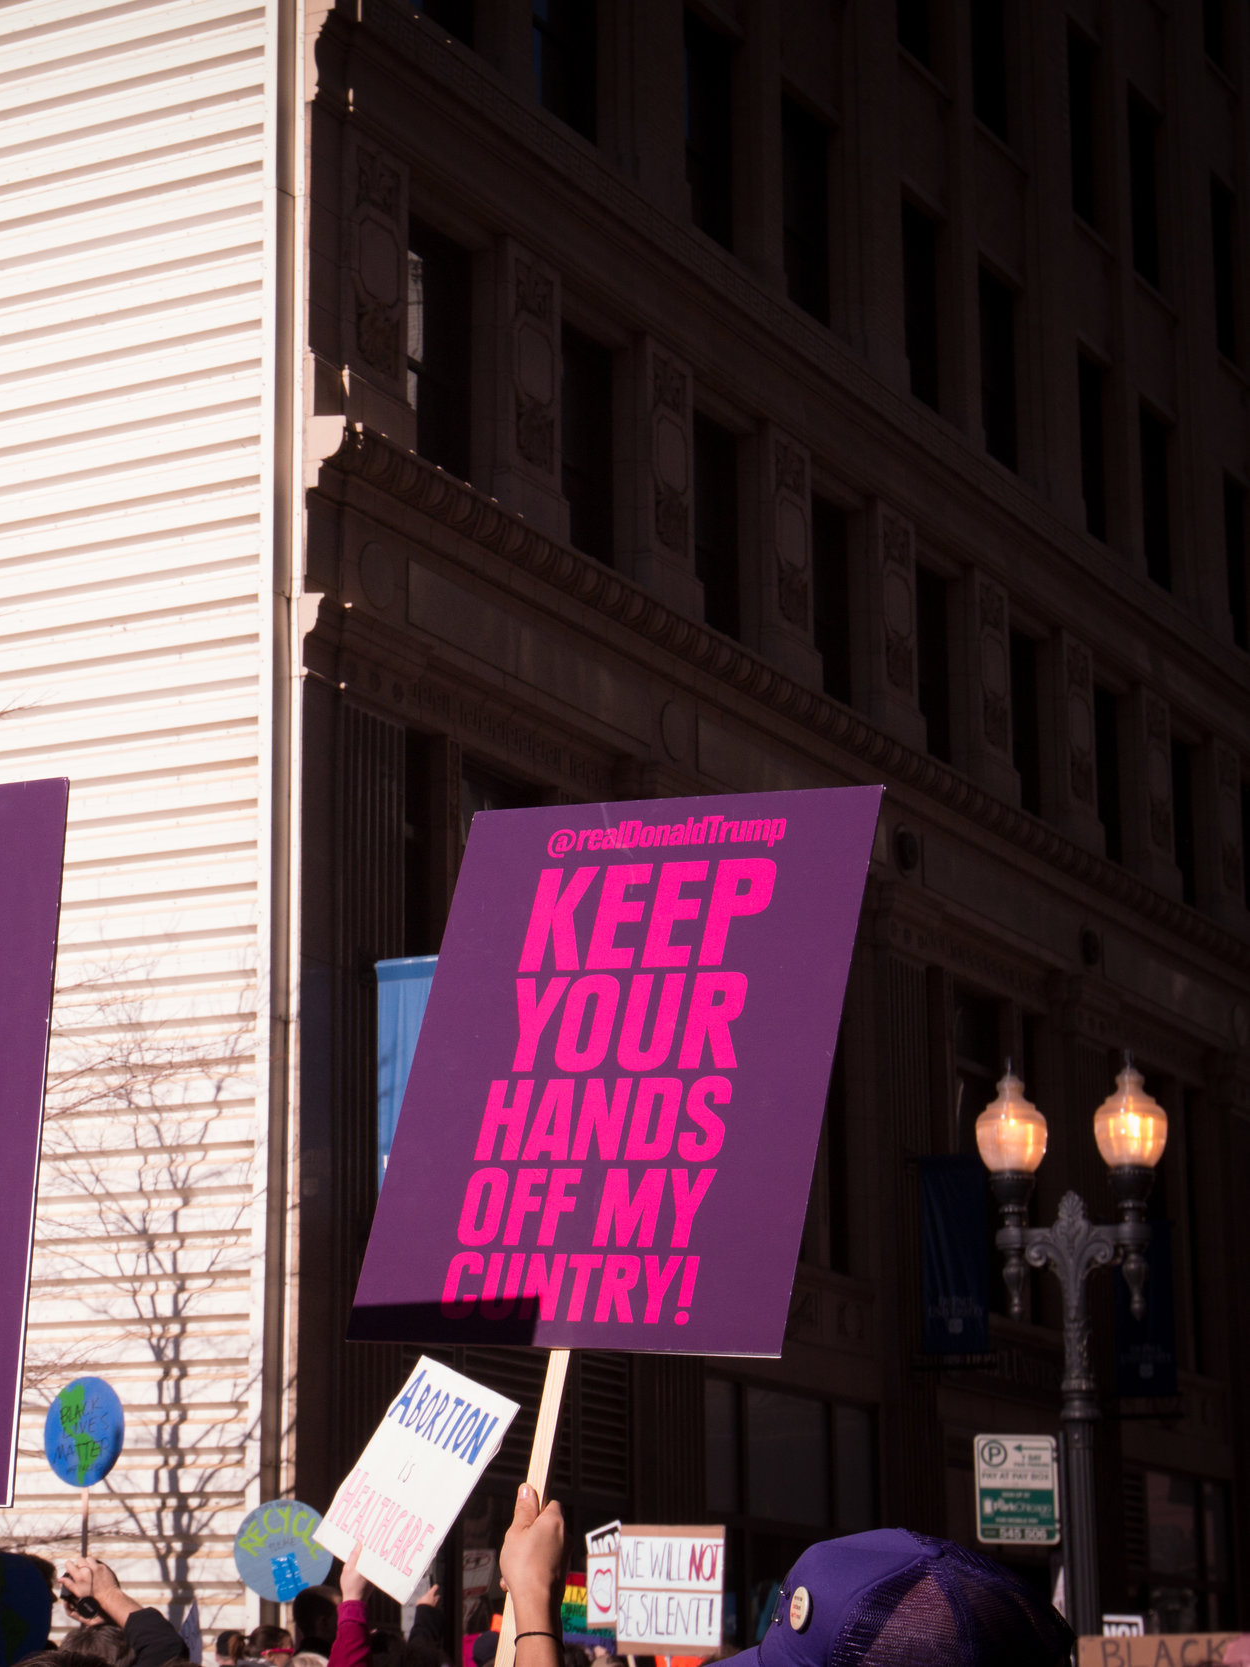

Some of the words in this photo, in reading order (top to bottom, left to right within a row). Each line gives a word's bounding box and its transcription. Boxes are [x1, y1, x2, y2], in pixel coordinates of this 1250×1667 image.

[547, 815, 788, 858] @realDonaldTrump
[518, 858, 777, 972] KEEP
[512, 972, 748, 1072] YOUR
[474, 1076, 732, 1162] HANDS
[457, 1167, 582, 1246] OFF
[592, 1168, 717, 1248] MY
[440, 1251, 701, 1326] CUNTRY!
[388, 1370, 499, 1465] ABORTION
[328, 1468, 435, 1577] HEALTHCARE
[619, 1539, 645, 1580] WE
[650, 1541, 686, 1582] WILL
[688, 1543, 725, 1582] NOT
[618, 1593, 633, 1637] BE
[636, 1593, 714, 1638] SILENT!
